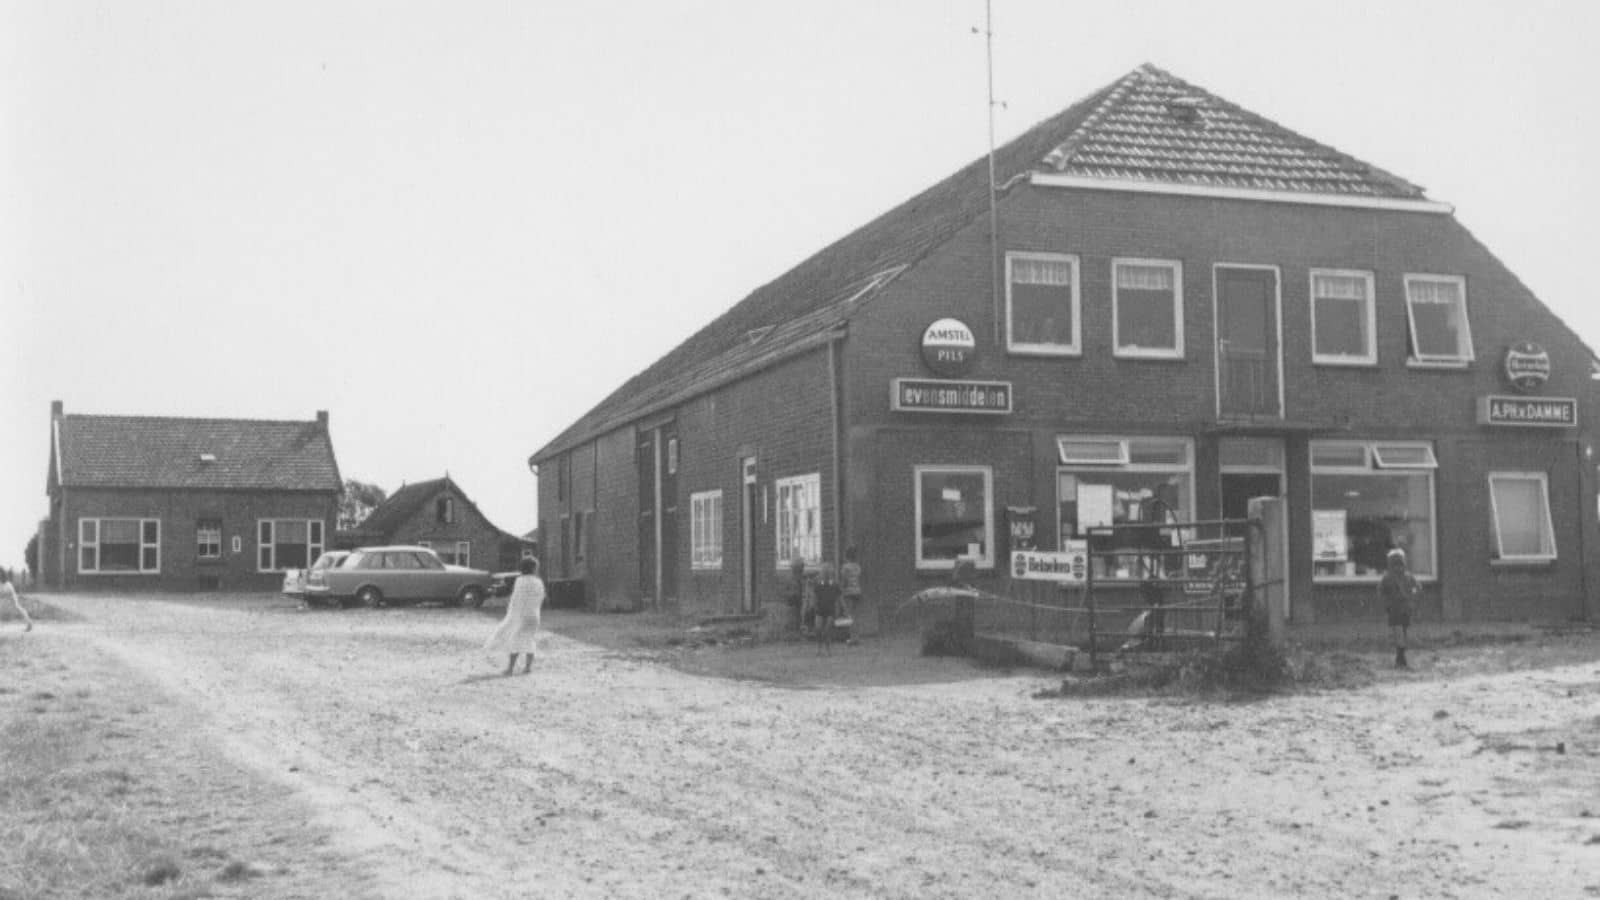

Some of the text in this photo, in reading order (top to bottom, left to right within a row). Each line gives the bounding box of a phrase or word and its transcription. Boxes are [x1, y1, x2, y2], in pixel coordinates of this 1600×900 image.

[927, 329, 971, 341] AMSTEL
[938, 350, 964, 361] PILS
[901, 382, 1006, 406] levensmiddelen
